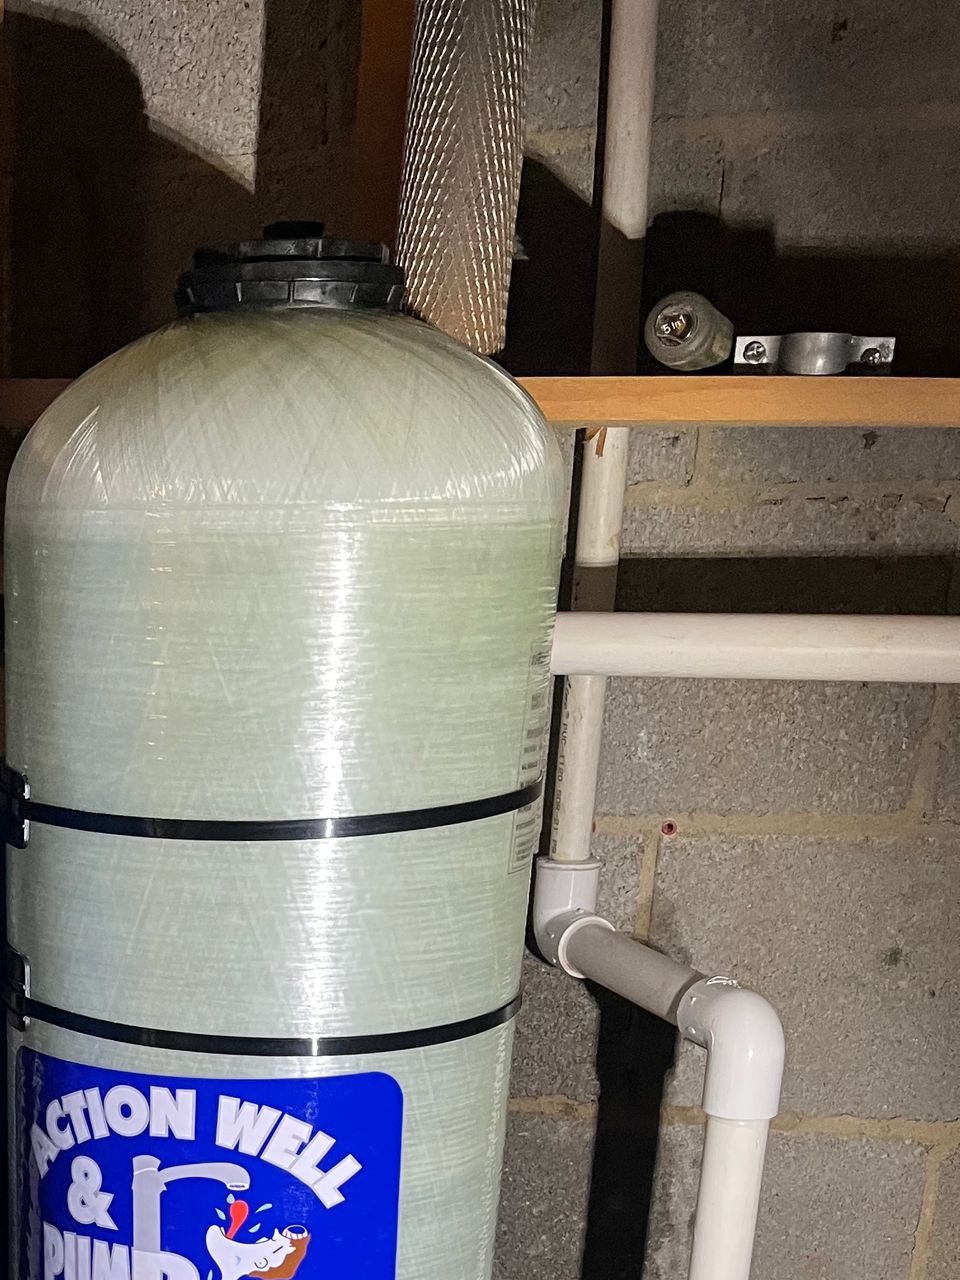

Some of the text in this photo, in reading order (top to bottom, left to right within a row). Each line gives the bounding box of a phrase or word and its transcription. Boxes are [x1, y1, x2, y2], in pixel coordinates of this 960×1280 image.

[661, 323, 671, 334] 5
[30, 1084, 363, 1210] ACTION WELL
[66, 1154, 119, 1231] &
